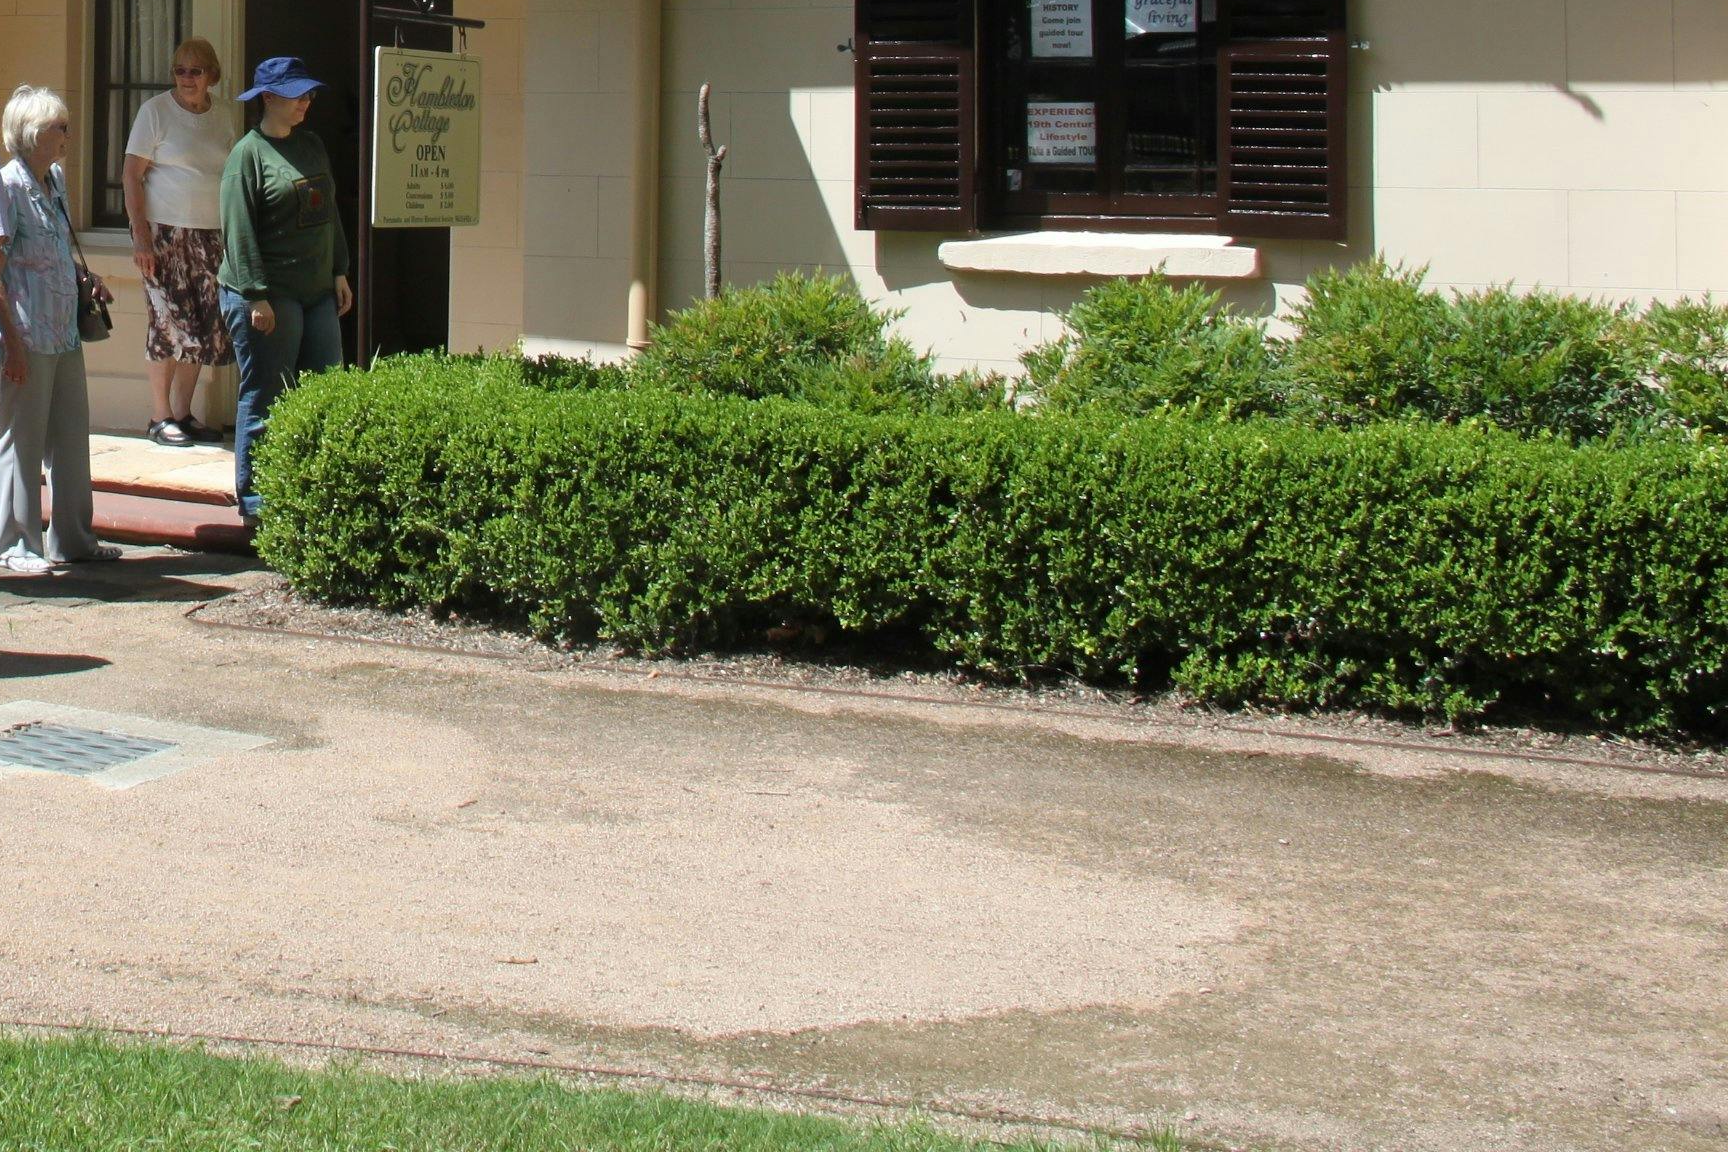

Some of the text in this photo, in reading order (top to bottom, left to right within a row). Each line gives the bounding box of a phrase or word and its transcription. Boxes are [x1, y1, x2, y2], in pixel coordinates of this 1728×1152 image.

[1042, 3, 1079, 12] HISTORY
[1041, 17, 1082, 26] Come join
[1146, 9, 1188, 28] living
[1039, 29, 1085, 39] guided tour
[387, 62, 476, 111] Hambledon
[1025, 108, 1096, 117] EXPERIENC
[1055, 120, 1096, 130] Centur
[388, 109, 450, 154] Cottage
[1039, 132, 1089, 143] Lifestyle
[416, 143, 447, 162] OPEN
[1052, 146, 1077, 157] Guided
[1078, 146, 1096, 157] TOU
